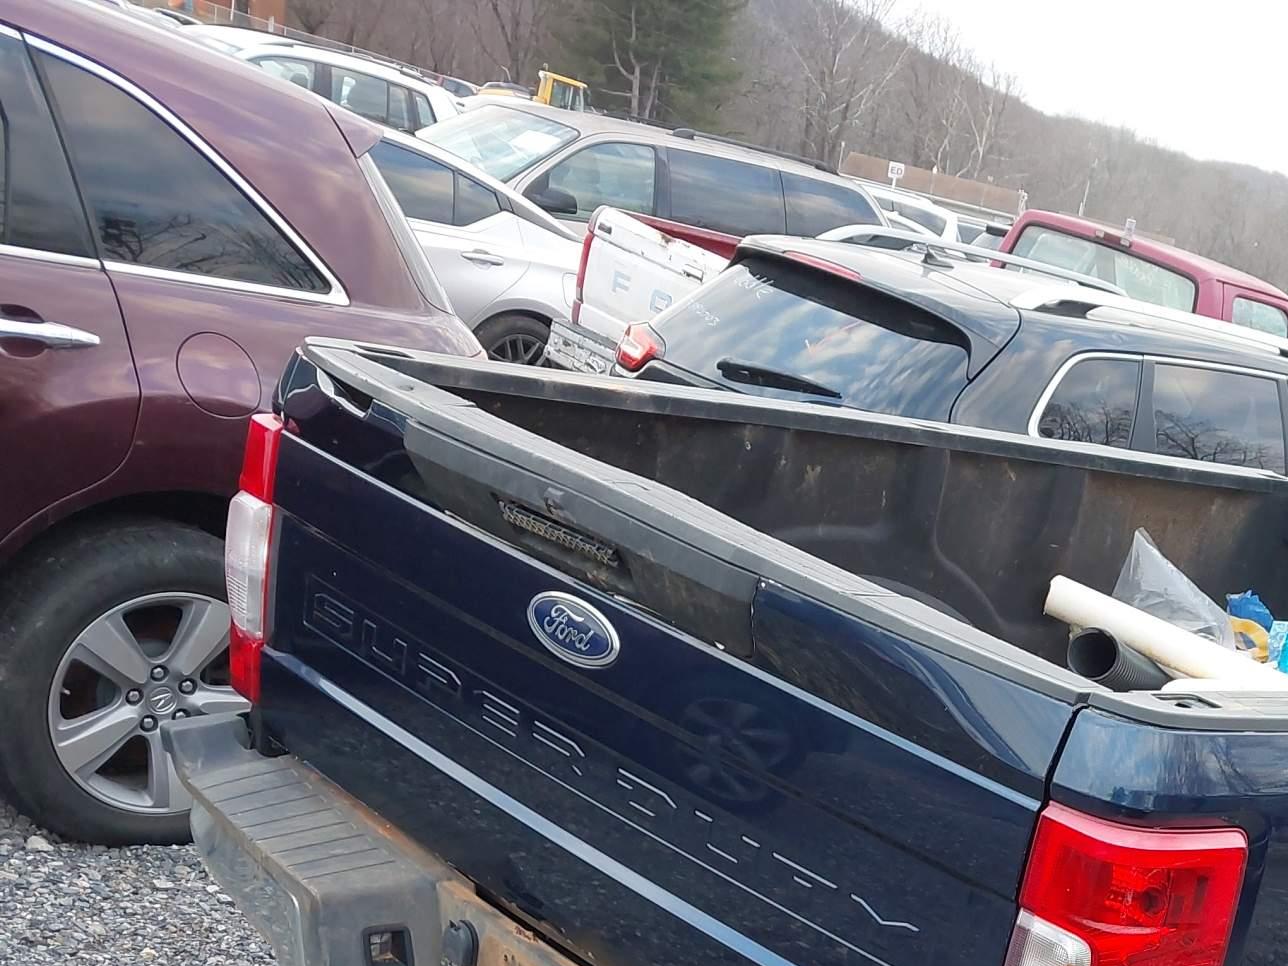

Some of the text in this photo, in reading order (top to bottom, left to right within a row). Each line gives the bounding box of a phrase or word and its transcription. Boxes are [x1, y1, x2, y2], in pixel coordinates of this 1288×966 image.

[543, 604, 592, 651] Ford
[312, 592, 921, 948] SUPER DUTY
